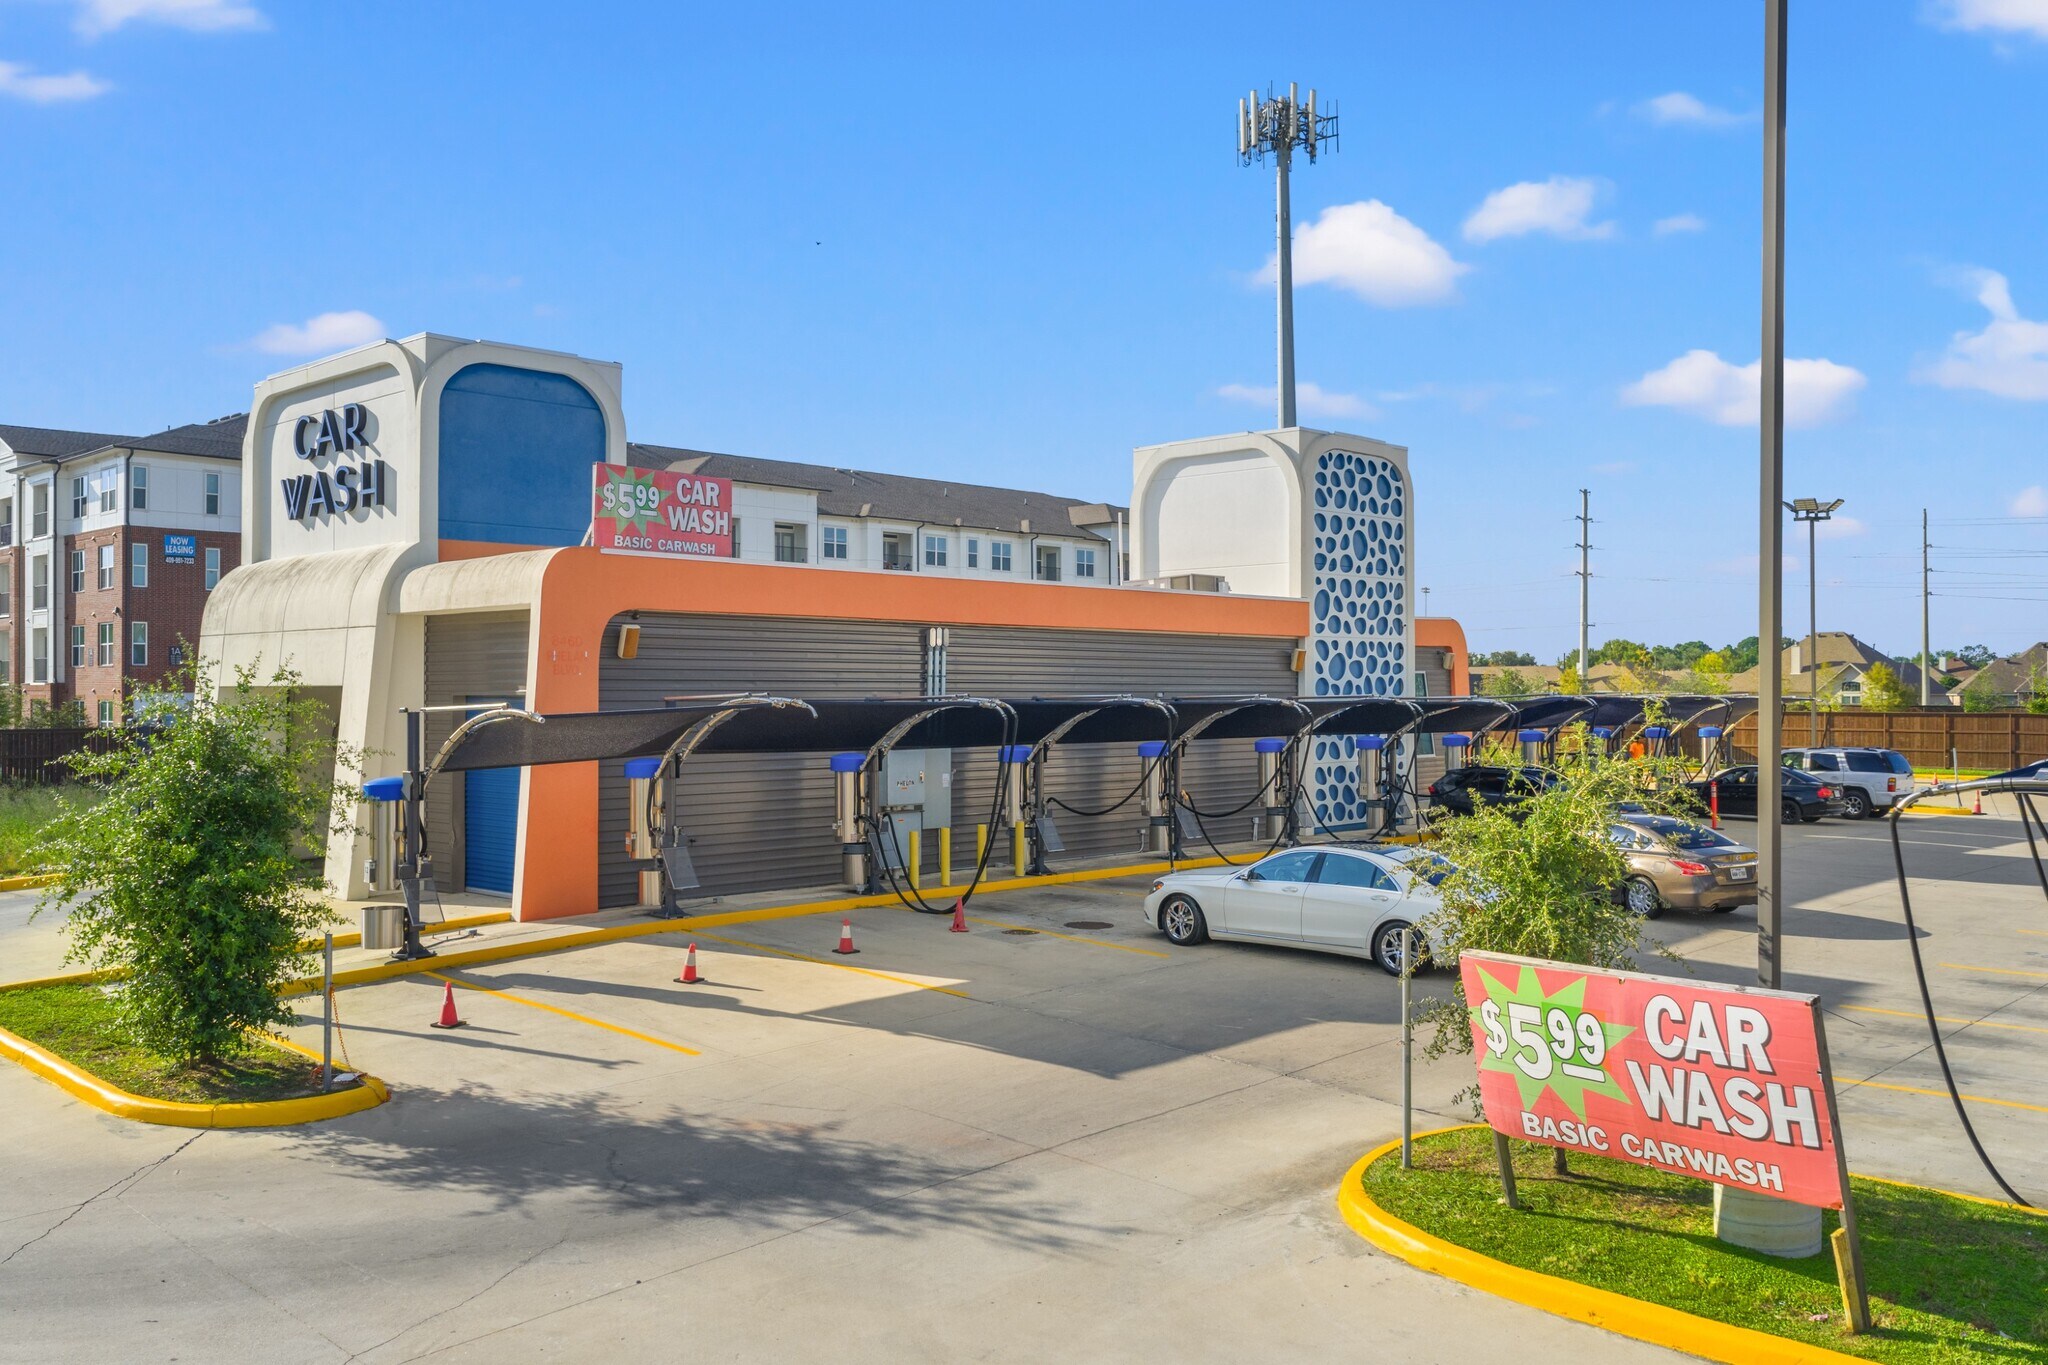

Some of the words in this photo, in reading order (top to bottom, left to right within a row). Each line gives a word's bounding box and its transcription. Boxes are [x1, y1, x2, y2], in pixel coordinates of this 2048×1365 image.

[293, 403, 369, 460] CAR
[281, 459, 385, 520] WASH
[676, 478, 720, 507] CAR
[667, 506, 729, 536] WASH
[165, 545, 194, 555] LEASING
[170, 536, 189, 545] NOW
[614, 535, 653, 550] BASIC
[658, 539, 716, 555] CARWASH
[171, 647, 181, 655] 1A
[1643, 993, 1775, 1074] CAR
[1625, 1058, 1823, 1150] WASH
[1520, 1110, 1609, 1151] BASIC
[1620, 1132, 1784, 1193] CARWASH
